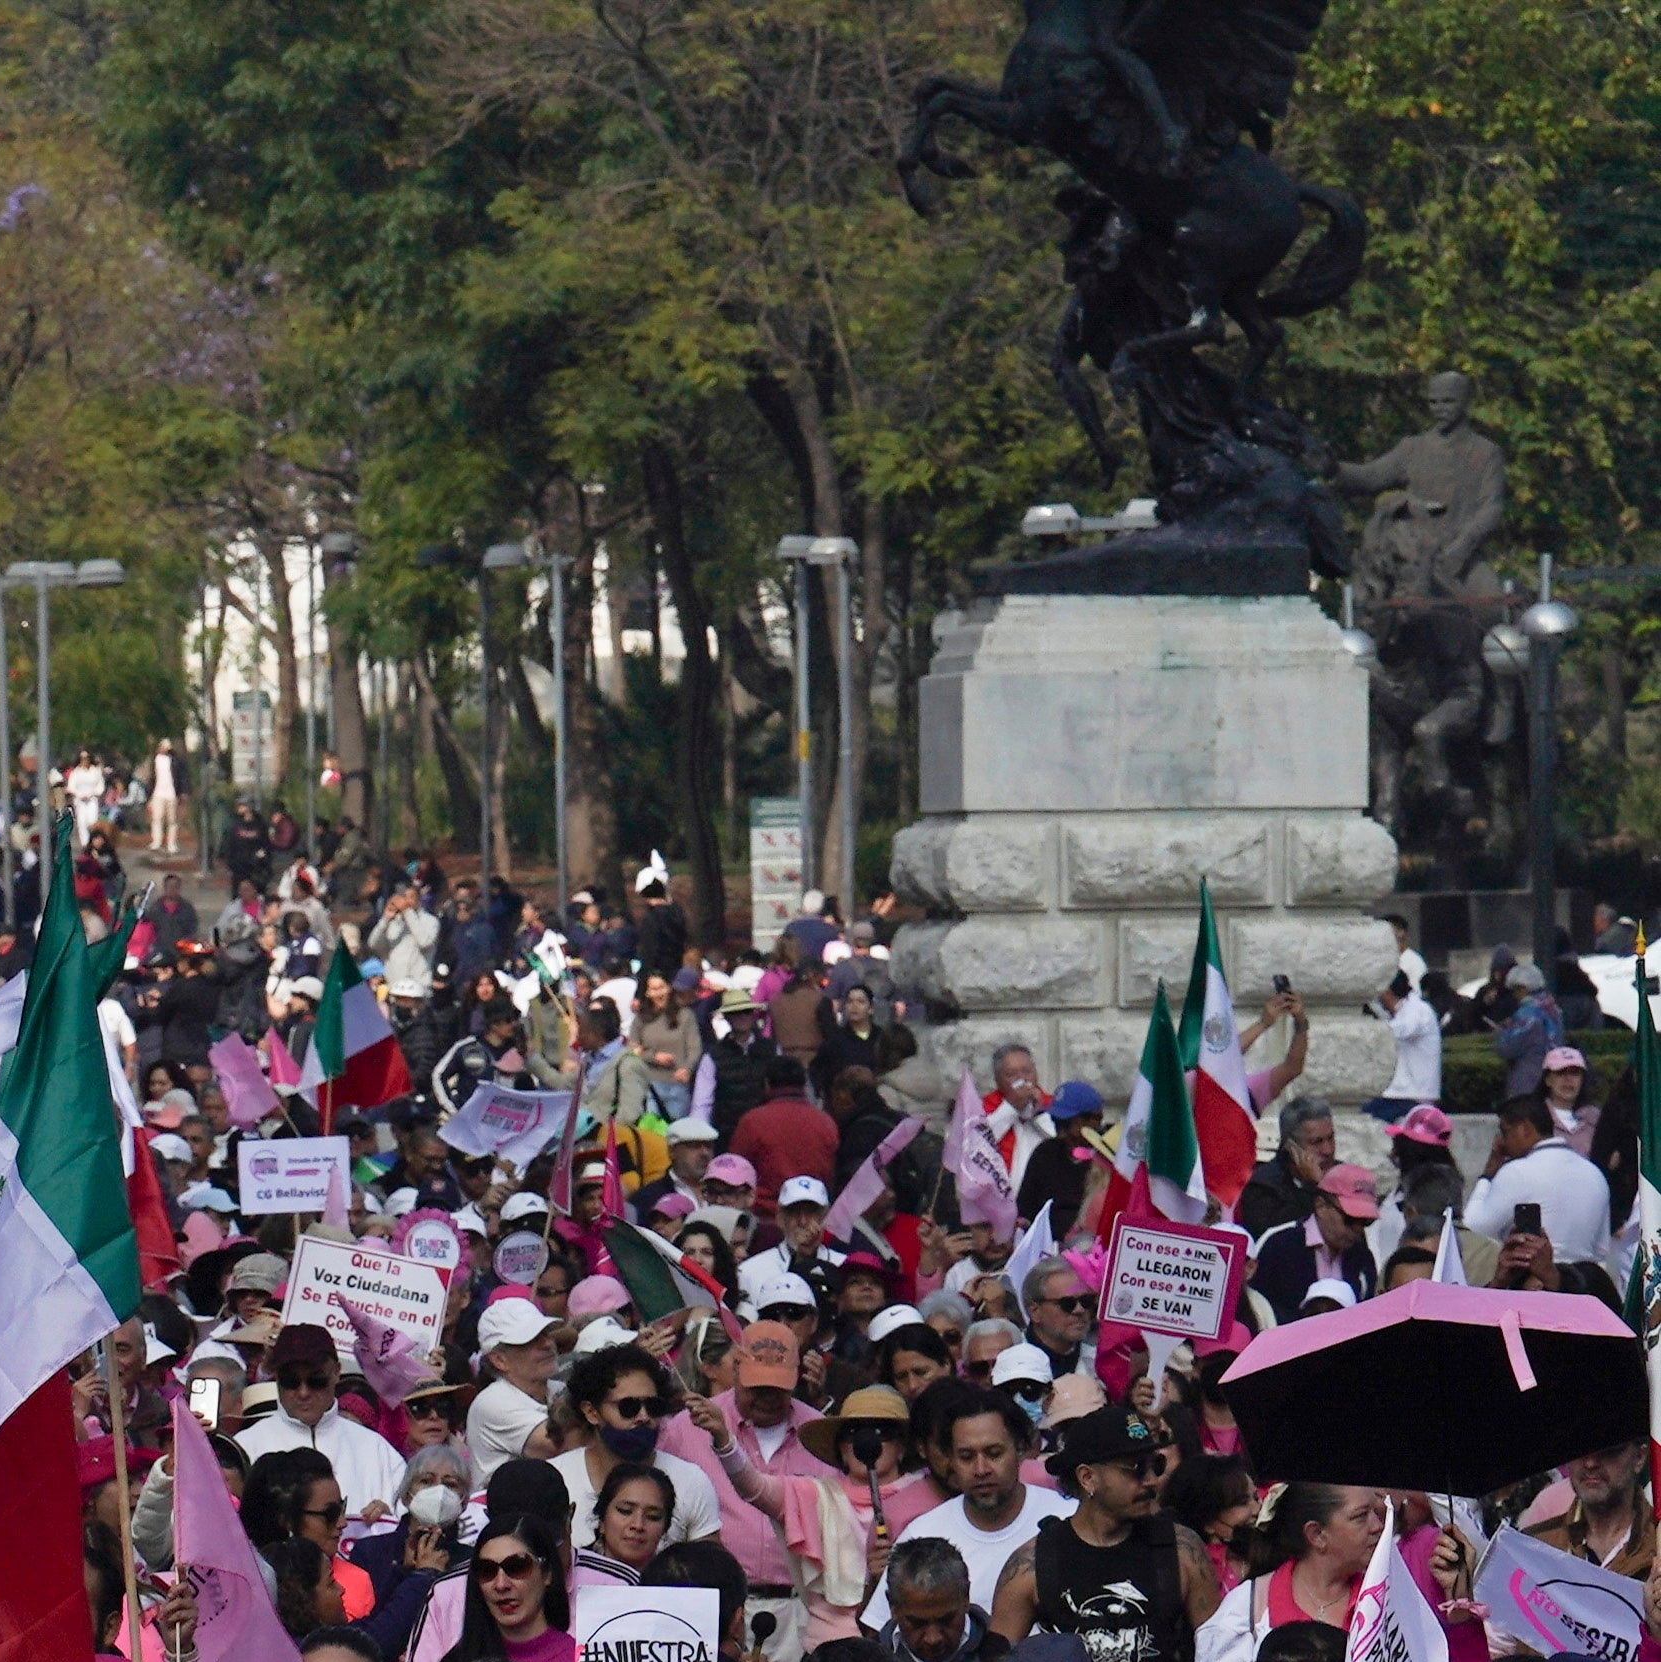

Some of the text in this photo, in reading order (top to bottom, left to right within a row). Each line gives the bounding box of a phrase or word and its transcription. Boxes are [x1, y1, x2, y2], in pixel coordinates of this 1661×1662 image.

[276, 1187, 328, 1199] Bellavist
[1126, 1236, 1217, 1262] Con ese INE
[350, 1252, 402, 1276] Que la
[1136, 1259, 1212, 1283] LLEGARON
[313, 1266, 430, 1304] Voz Ciudadana
[1120, 1272, 1213, 1299] Con ese INE
[301, 1286, 322, 1302] Se
[398, 1310, 418, 1323] en
[422, 1313, 438, 1327] el
[1141, 1296, 1192, 1316] SE VAN
